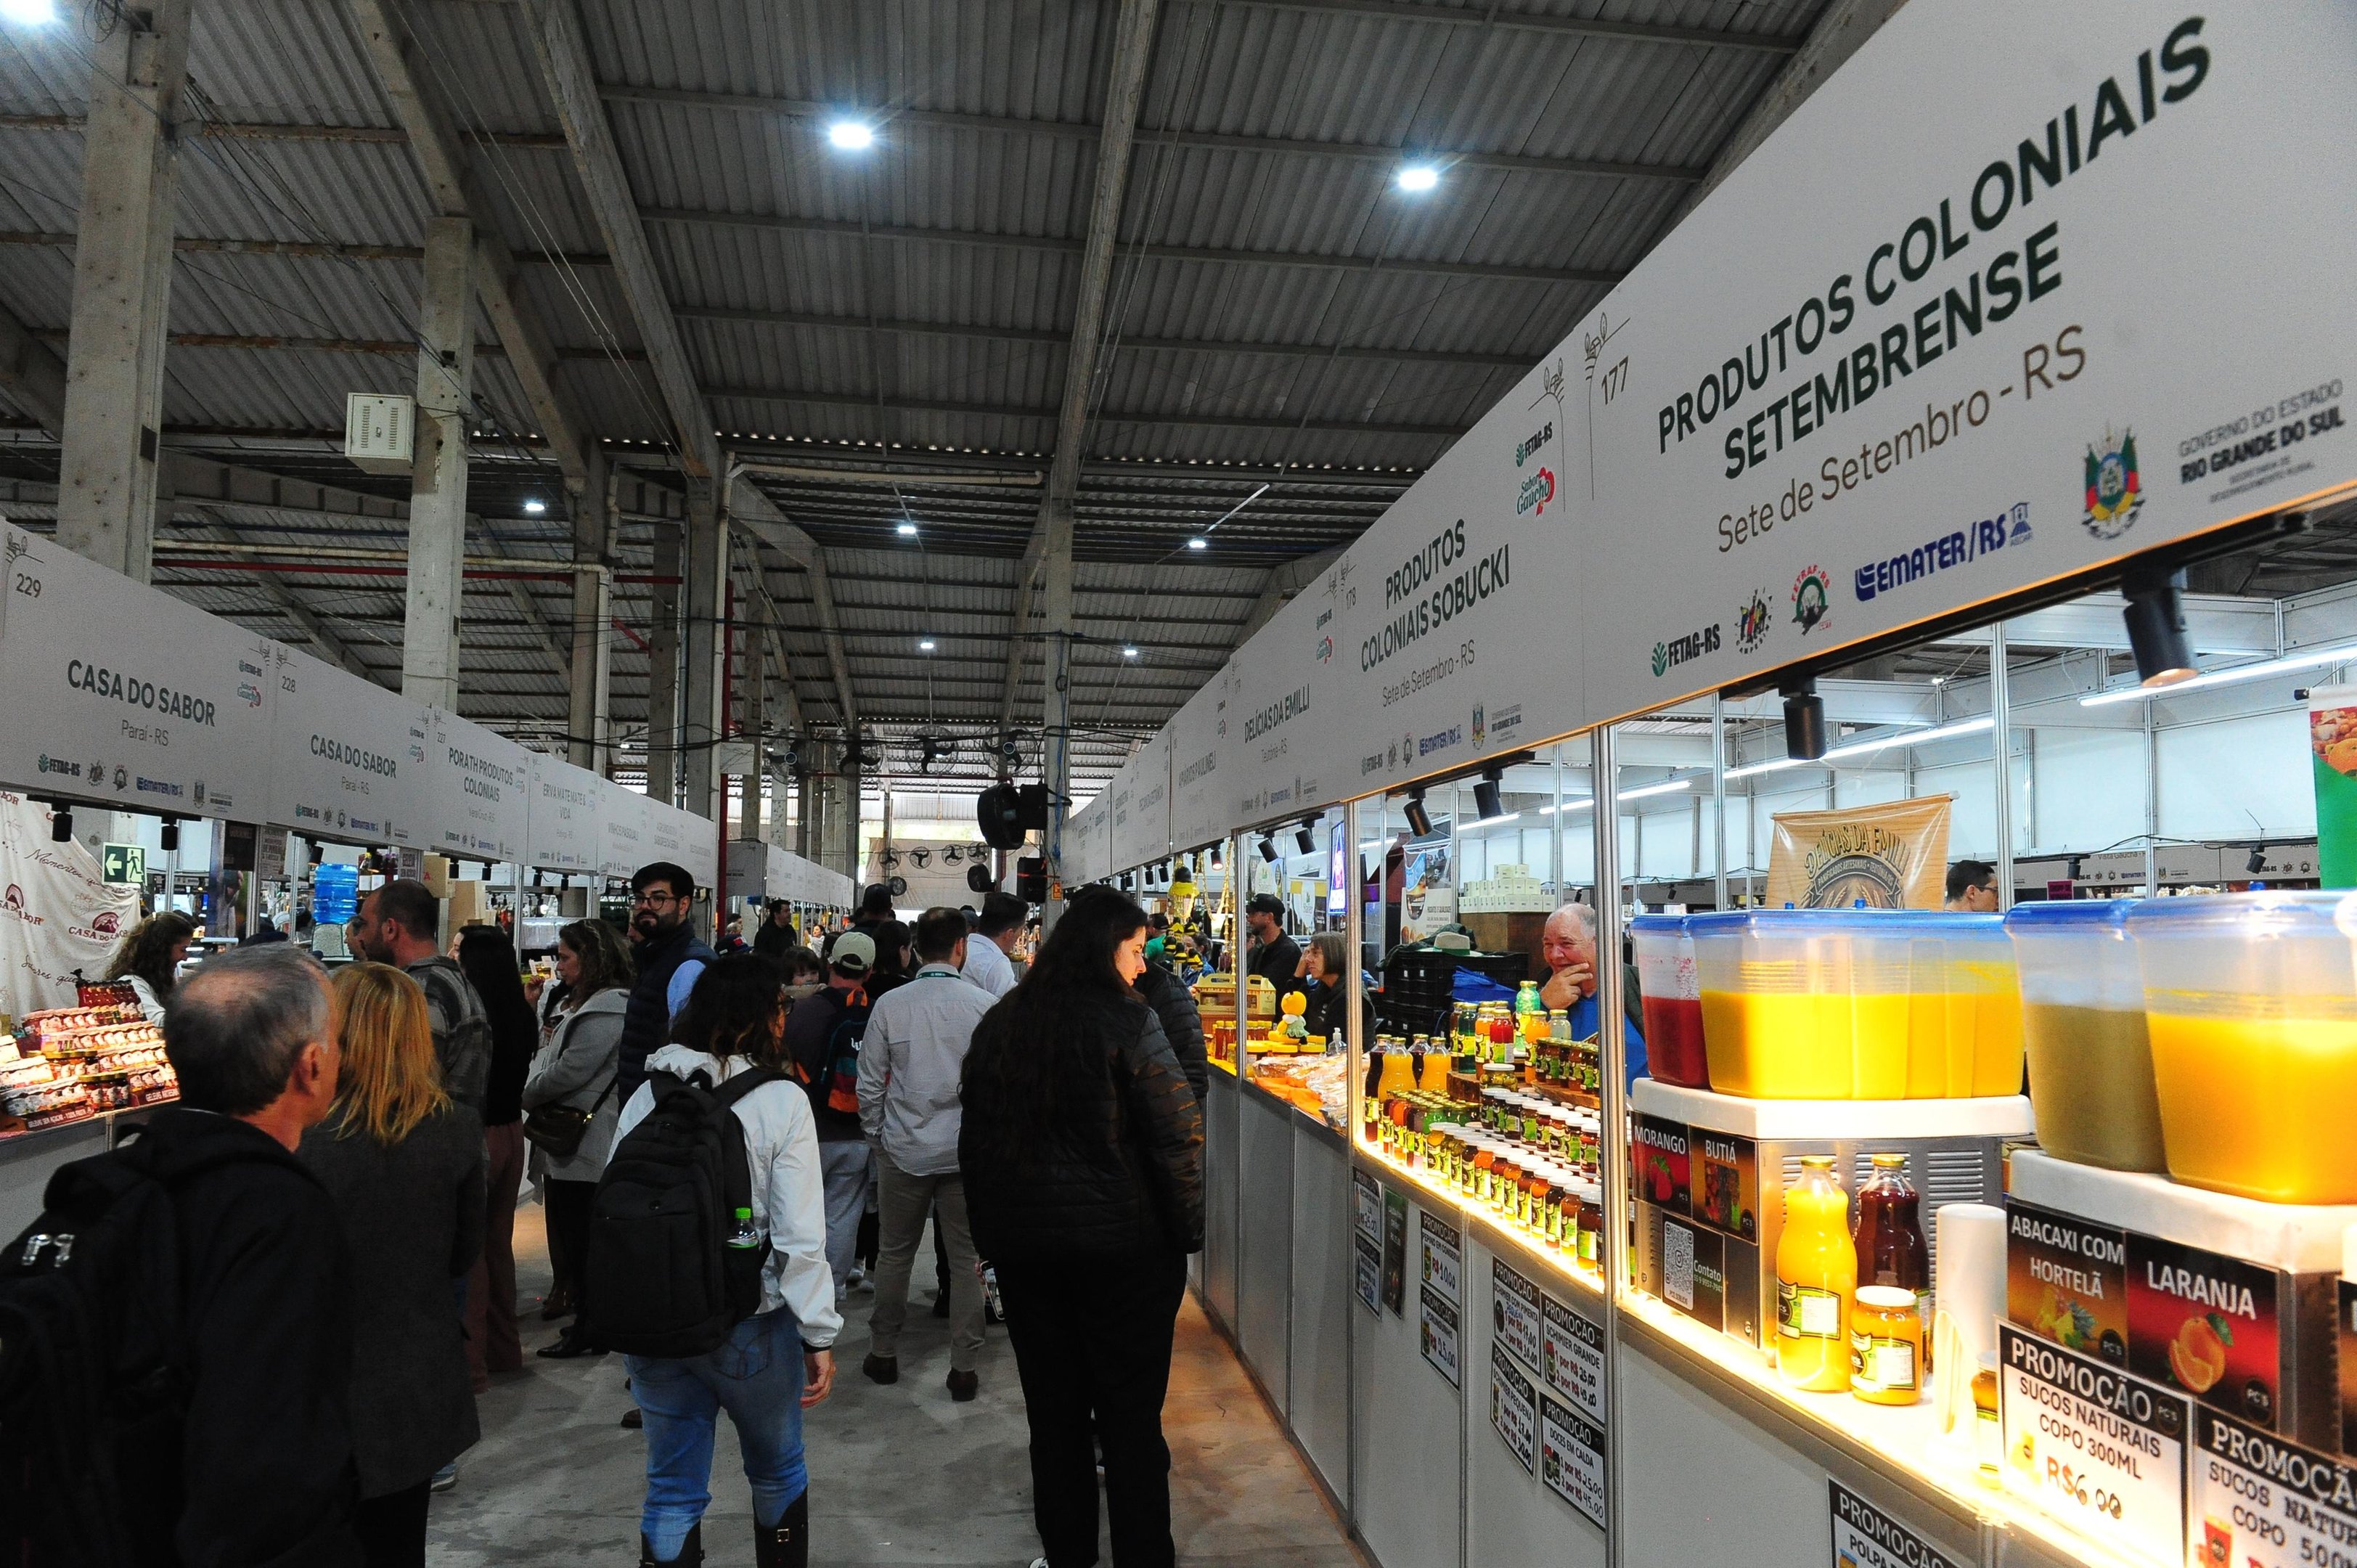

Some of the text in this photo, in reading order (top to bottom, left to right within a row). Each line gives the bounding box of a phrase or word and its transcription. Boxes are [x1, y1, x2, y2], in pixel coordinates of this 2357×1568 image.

[1659, 16, 2210, 454] PRODUTOS COLONIAIS
[1725, 221, 2062, 480] SETEMBRENSE
[1601, 355, 1629, 405] 177
[1718, 502, 1773, 553] Sete
[1781, 480, 1813, 521] de
[1821, 388, 1990, 502] Setembro
[2024, 324, 2086, 401] RS
[2179, 377, 2344, 458] GOVERNO DO ESTADO
[1524, 421, 1553, 460] FETAG-RS
[2181, 457, 2207, 485] RIO
[2210, 430, 2277, 473] GRANDE
[2281, 419, 2305, 447] DO
[2310, 405, 2346, 436] SUL
[1386, 518, 1466, 610] PRODUTOS
[1876, 513, 2007, 593] EMATER/RS
[15, 573, 42, 599] 229
[1346, 586, 1357, 611] 178
[1361, 543, 1510, 673] COLONIAIS SOBUCKI
[1668, 623, 1721, 667] FETAG-RS
[67, 659, 216, 727] CASA DO SABOR
[282, 675, 296, 693] 228
[1382, 639, 1475, 709] Sete de Setembro RS
[1243, 684, 1310, 744] DELÍCIAS DA EMILLI
[154, 728, 169, 747] RS
[310, 734, 396, 779] CASA DO SABOR
[449, 747, 513, 786] PORATH PRODUTOS
[464, 776, 500, 803] COLONIAIS
[1804, 822, 1911, 879] DELÍCIAS DA EMILLI
[68, 926, 97, 942] CASA
[1634, 1124, 1686, 1156] MORANGO
[1705, 1139, 1737, 1165] BUTIÁ
[1423, 1214, 1455, 1246] PROMOÇÃO
[2011, 1214, 2125, 1265] ABACAXI COM
[1431, 1256, 1439, 1276] R$
[1495, 1262, 1533, 1302] PROMOÇÃO
[1693, 1259, 1722, 1282] Contato
[2030, 1257, 2104, 1300] HORTELÃ
[1422, 1292, 1453, 1326] PROMOÇÃO
[2146, 1260, 2258, 1320] LARANJA
[1545, 1299, 1596, 1344] PROMOÇÃO
[1429, 1332, 1437, 1355] R$
[1573, 1342, 1601, 1370] GRANDE
[1494, 1347, 1529, 1400] PROMOÇÃO
[1559, 1355, 1569, 1371] por
[1570, 1359, 1579, 1378] R$
[1561, 1373, 1571, 1391] por
[1571, 1380, 1580, 1398] R$
[2011, 1336, 2152, 1424] PROMOÇÃO
[1511, 1408, 1518, 1427] R$
[1511, 1429, 1517, 1446] R$
[1545, 1400, 1592, 1446] PROMOÇÃO
[2019, 1376, 2161, 1458] SUCOS NATURAIS
[1549, 1426, 1595, 1469] DOCES EM CALDA
[2039, 1413, 2142, 1480] COPO 300ML
[2212, 1418, 2357, 1514] PROMOÇÃ
[1564, 1460, 1574, 1477] por
[1574, 1466, 1582, 1485] R$
[1566, 1479, 1575, 1496] por
[1574, 1485, 1582, 1503] R$
[2209, 1461, 2271, 1508] SUCOS
[2232, 1504, 2286, 1547] COPO
[1849, 1532, 1887, 1568] POLPA
